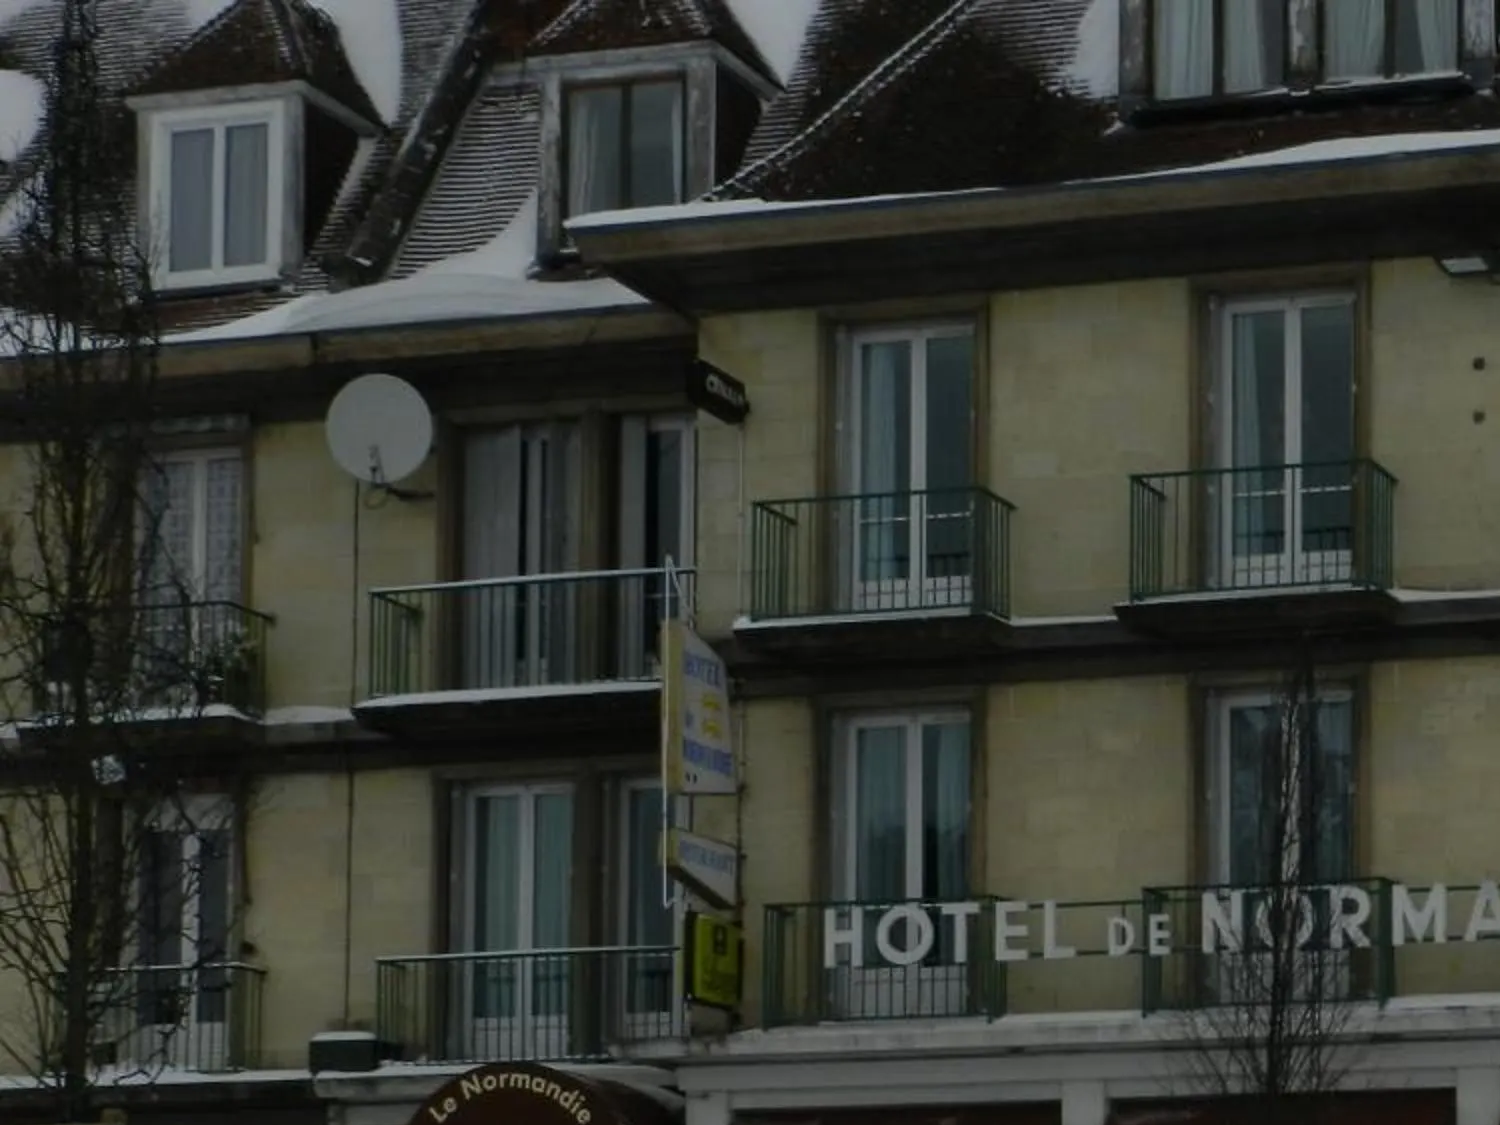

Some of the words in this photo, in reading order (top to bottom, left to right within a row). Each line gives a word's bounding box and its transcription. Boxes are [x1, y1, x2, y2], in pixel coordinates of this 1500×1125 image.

[824, 900, 1075, 968] HOTEL
[1107, 913, 1172, 957] DE
[429, 1096, 458, 1124] Le
[459, 1071, 591, 1125] Normandie
